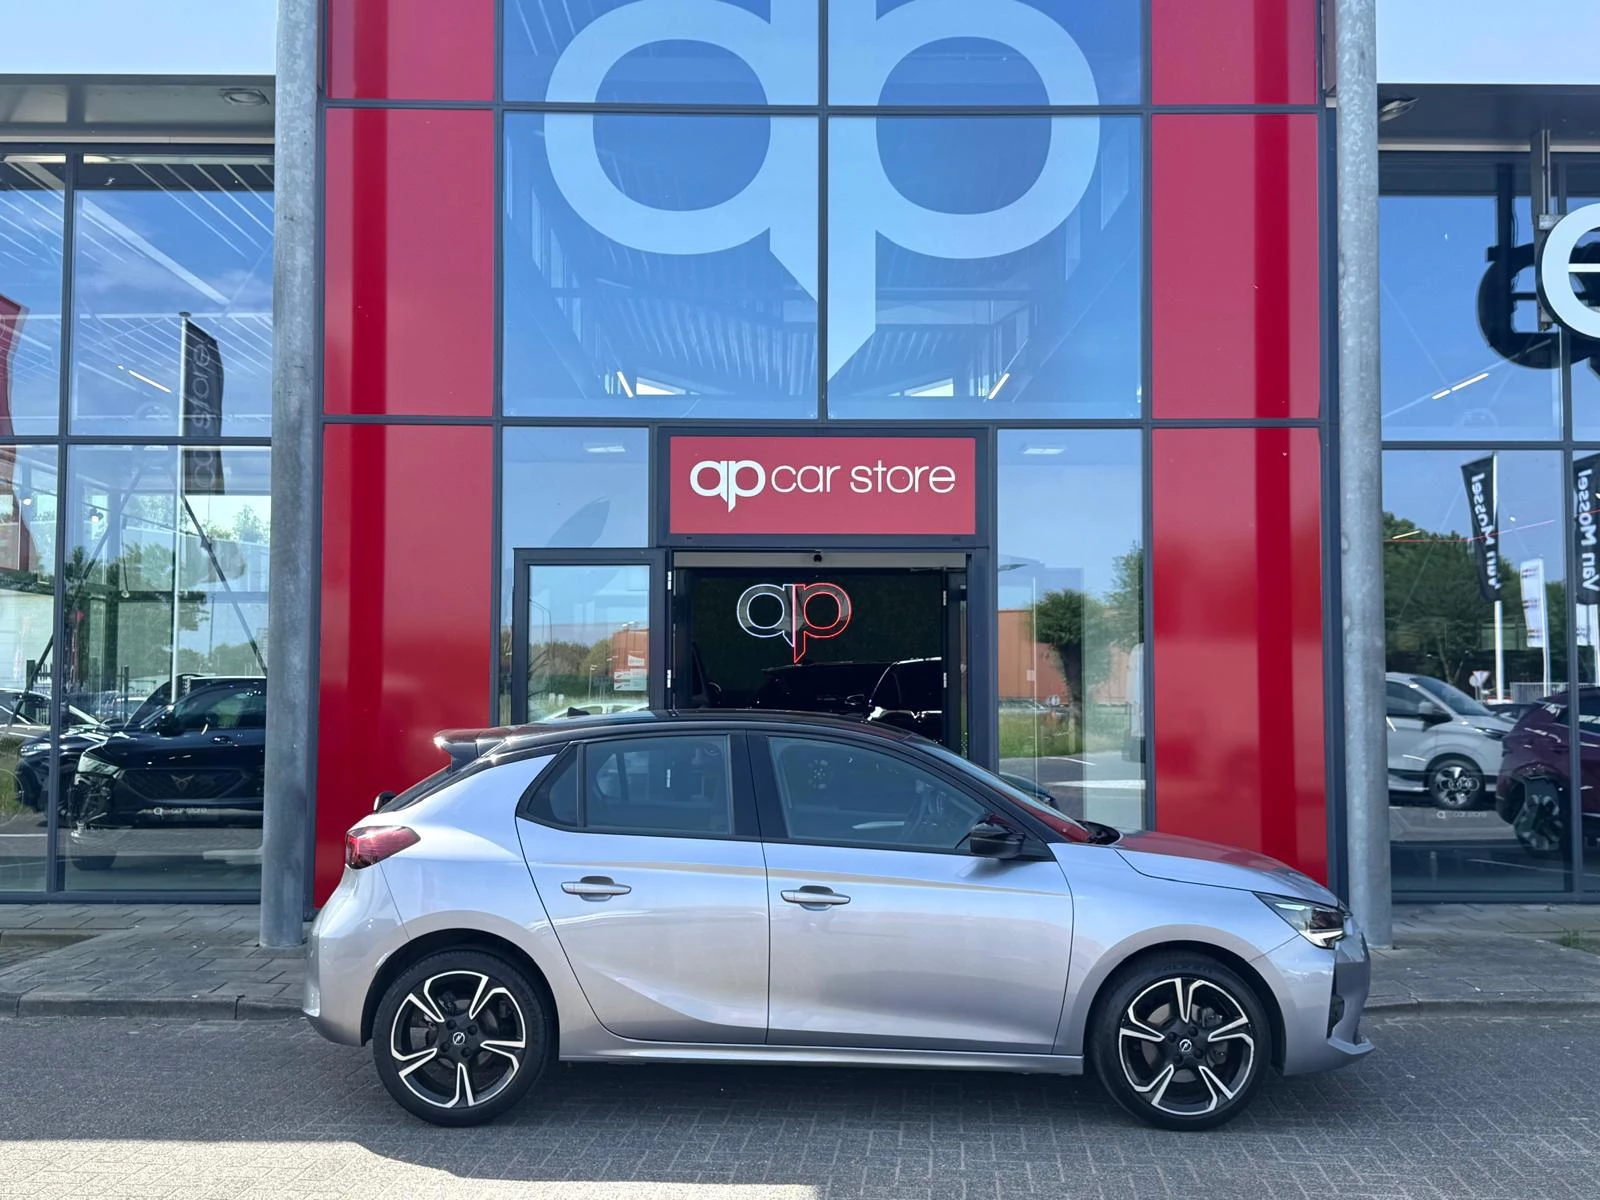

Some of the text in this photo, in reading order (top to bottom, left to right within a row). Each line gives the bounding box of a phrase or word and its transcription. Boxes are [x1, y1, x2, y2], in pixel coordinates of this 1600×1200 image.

[544, 0, 1100, 383] ap
[690, 460, 956, 512] ap car store
[737, 582, 852, 663] ap
